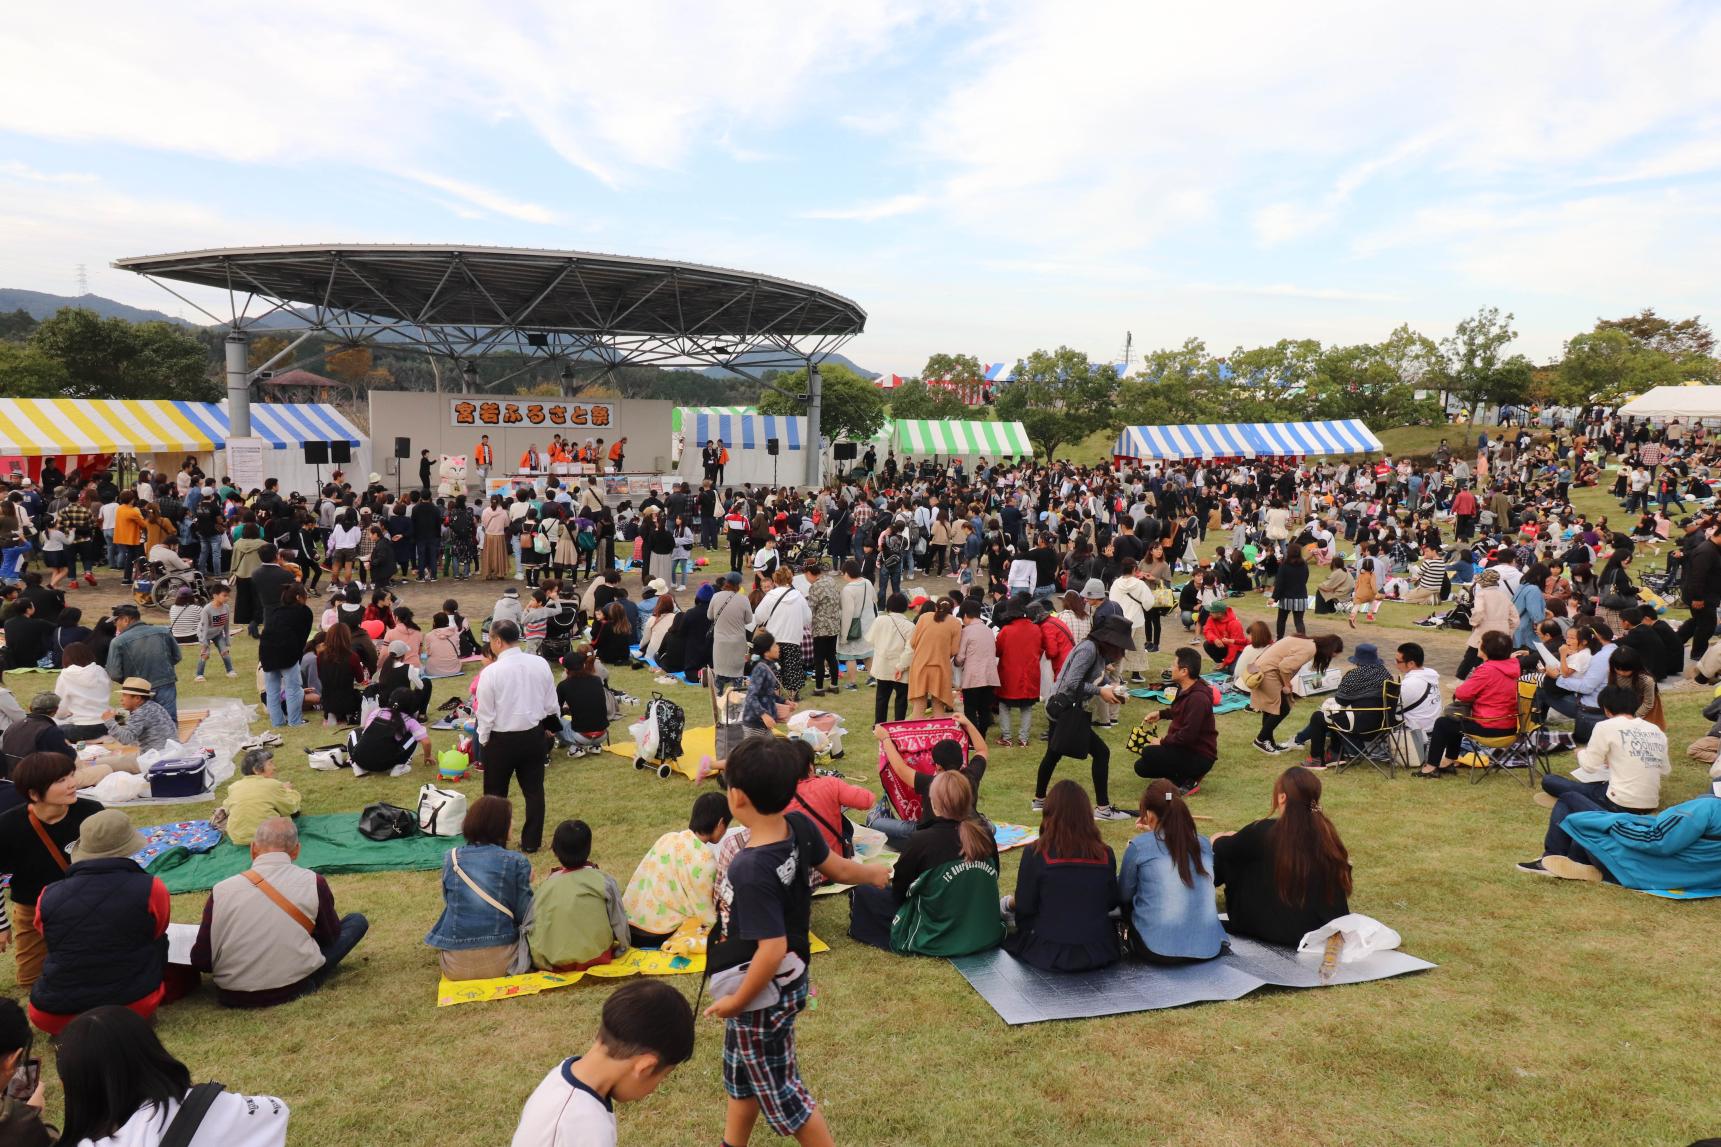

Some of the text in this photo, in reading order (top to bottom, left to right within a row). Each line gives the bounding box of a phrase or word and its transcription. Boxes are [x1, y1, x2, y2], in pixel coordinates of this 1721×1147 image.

[455, 402, 609, 426] 宮若ふるさと祭
[942, 871, 953, 883] FC
